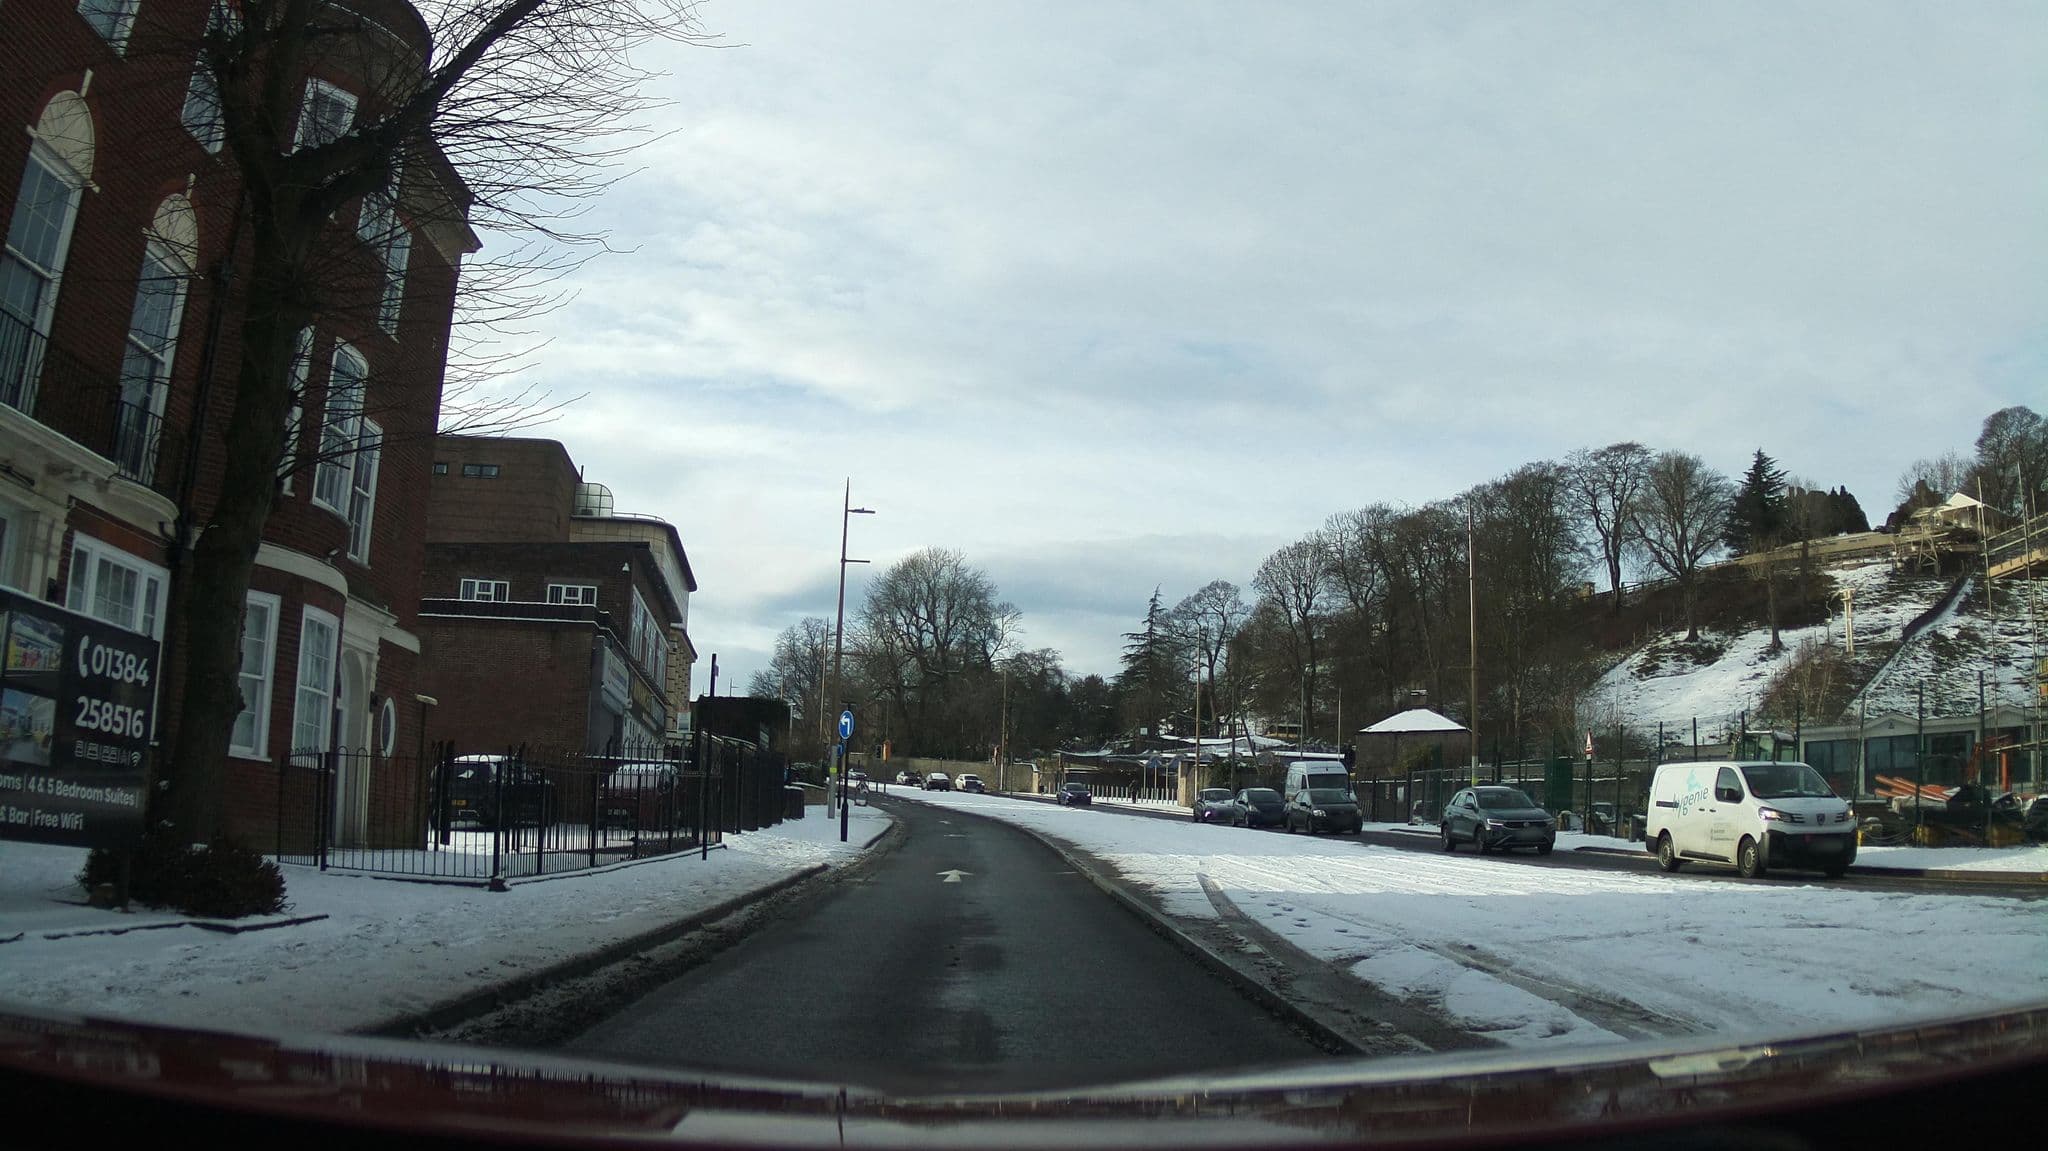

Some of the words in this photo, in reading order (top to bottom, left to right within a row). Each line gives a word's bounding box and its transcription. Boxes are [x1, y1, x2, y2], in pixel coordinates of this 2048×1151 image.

[91, 643, 150, 688] 01384
[75, 695, 145, 739] 258516
[28, 776, 36, 792] 4
[37, 777, 45, 793] &
[47, 778, 54, 795] 5
[55, 780, 102, 802] Bedroom
[104, 787, 135, 807] Suites
[9, 806, 28, 825] Bar
[34, 810, 58, 828] Free
[61, 812, 84, 830] WiFi
